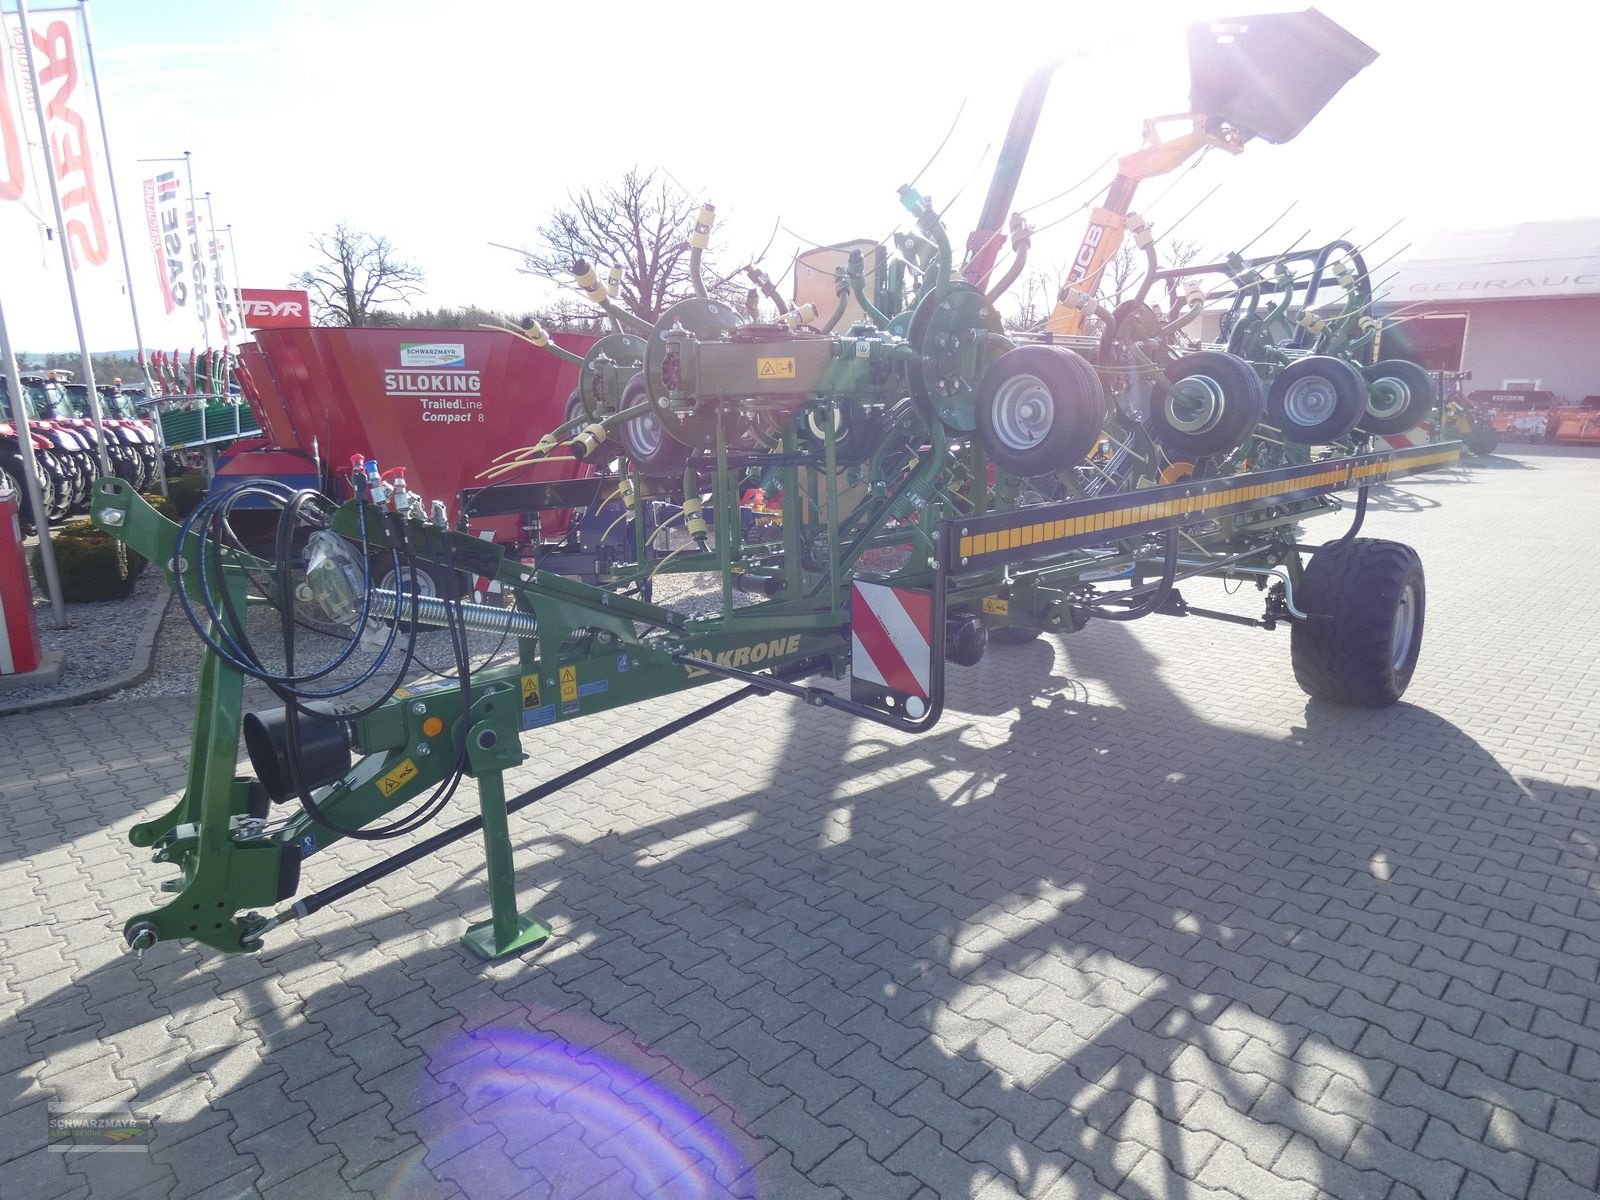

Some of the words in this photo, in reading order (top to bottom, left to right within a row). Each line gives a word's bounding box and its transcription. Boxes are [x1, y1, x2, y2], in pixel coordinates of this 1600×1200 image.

[1073, 225, 1104, 283] JCB
[238, 300, 303, 317] TEYR
[386, 375, 481, 391] SILOKING
[420, 399, 483, 410] TrailedLine
[422, 412, 471, 423] Compact
[478, 413, 485, 423] 8
[716, 634, 801, 668] KRONE
